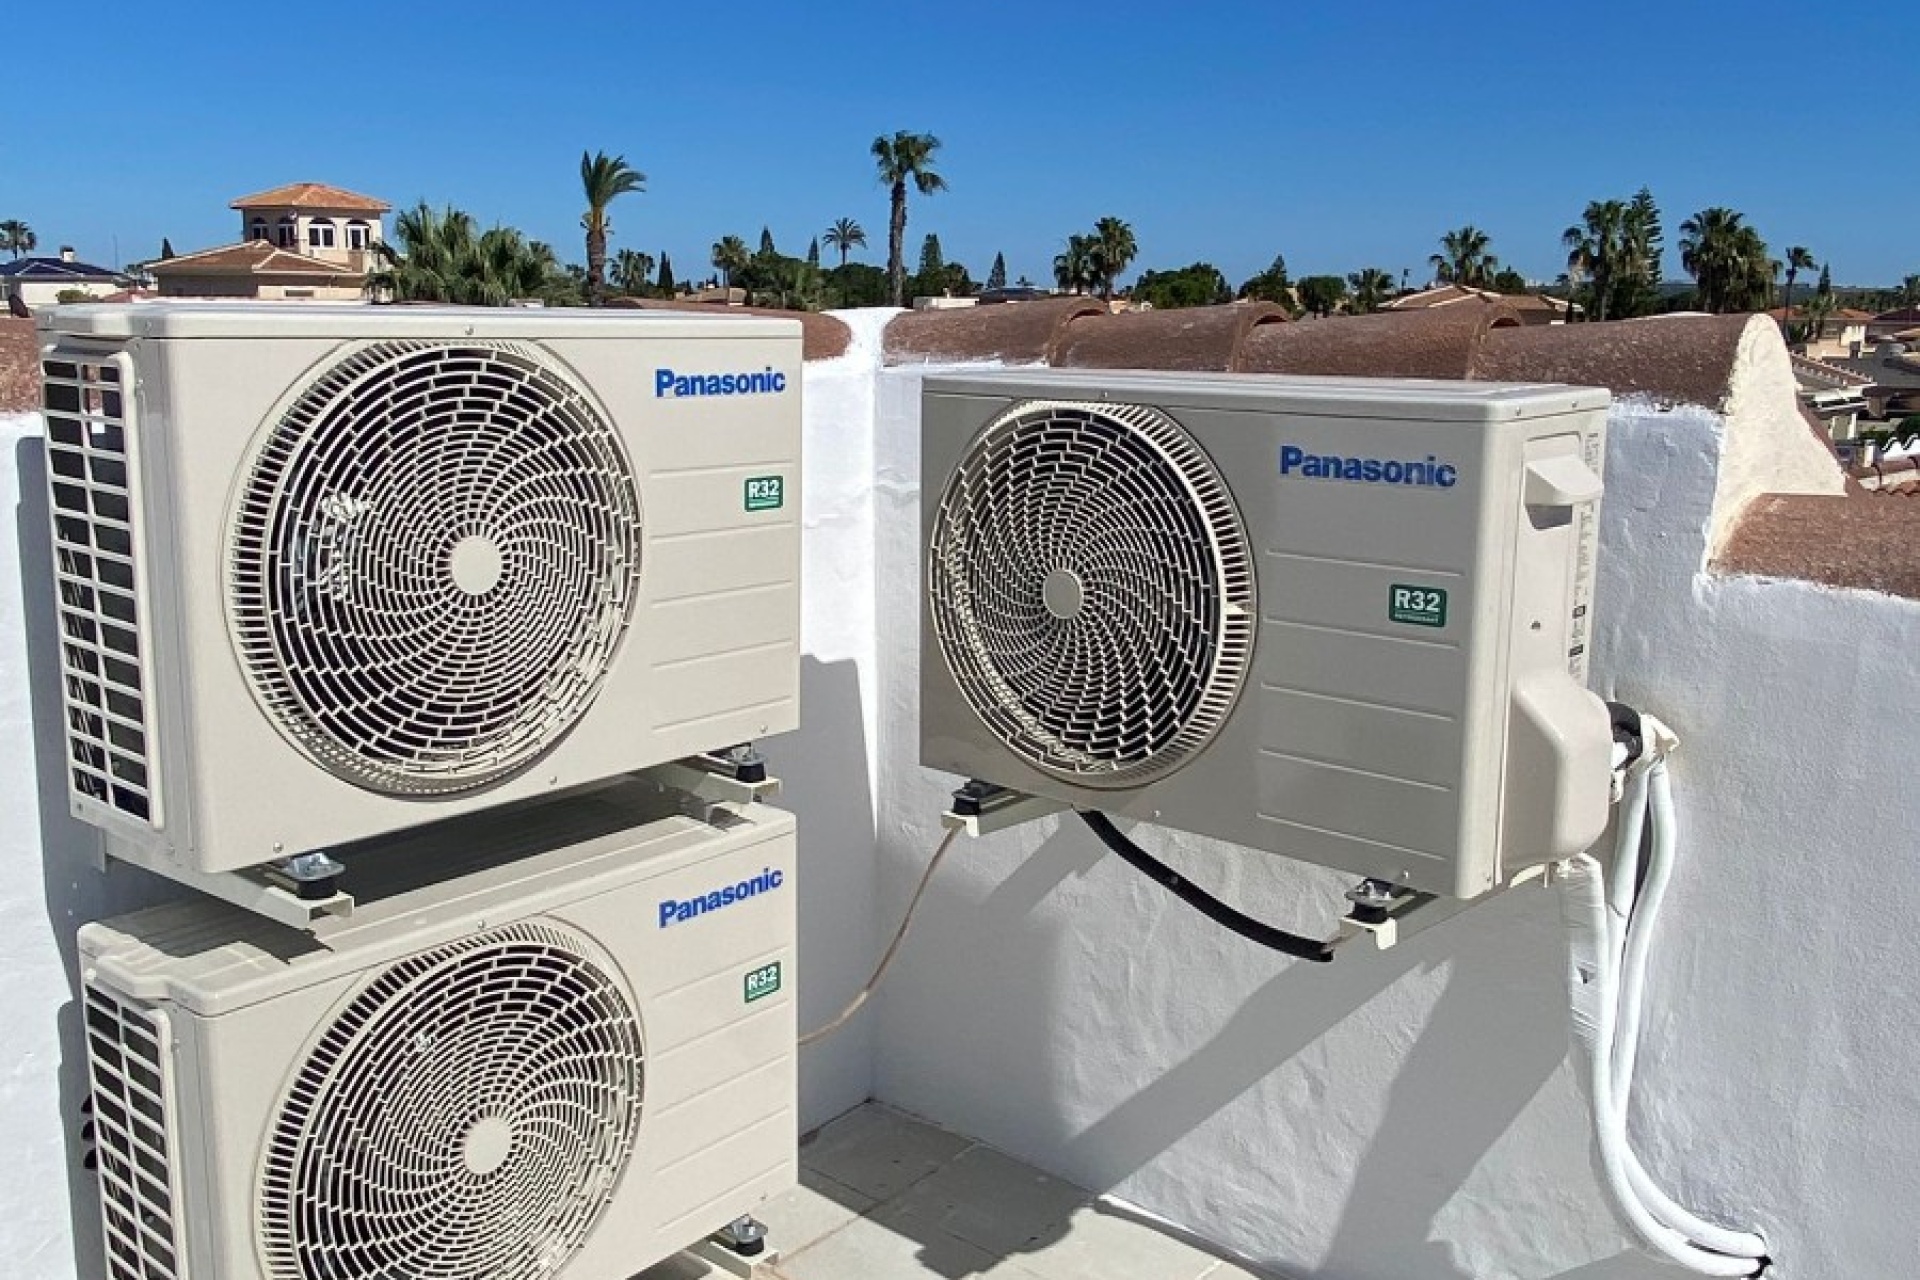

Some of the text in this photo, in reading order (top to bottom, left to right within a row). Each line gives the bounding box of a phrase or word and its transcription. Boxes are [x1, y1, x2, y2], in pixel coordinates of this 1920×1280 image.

[655, 367, 785, 398] Panasonic
[1280, 445, 1456, 487] Panasonic
[748, 479, 780, 498] R32
[1394, 588, 1441, 613] R32
[659, 867, 783, 928] Panasonic
[748, 966, 778, 991] R32
